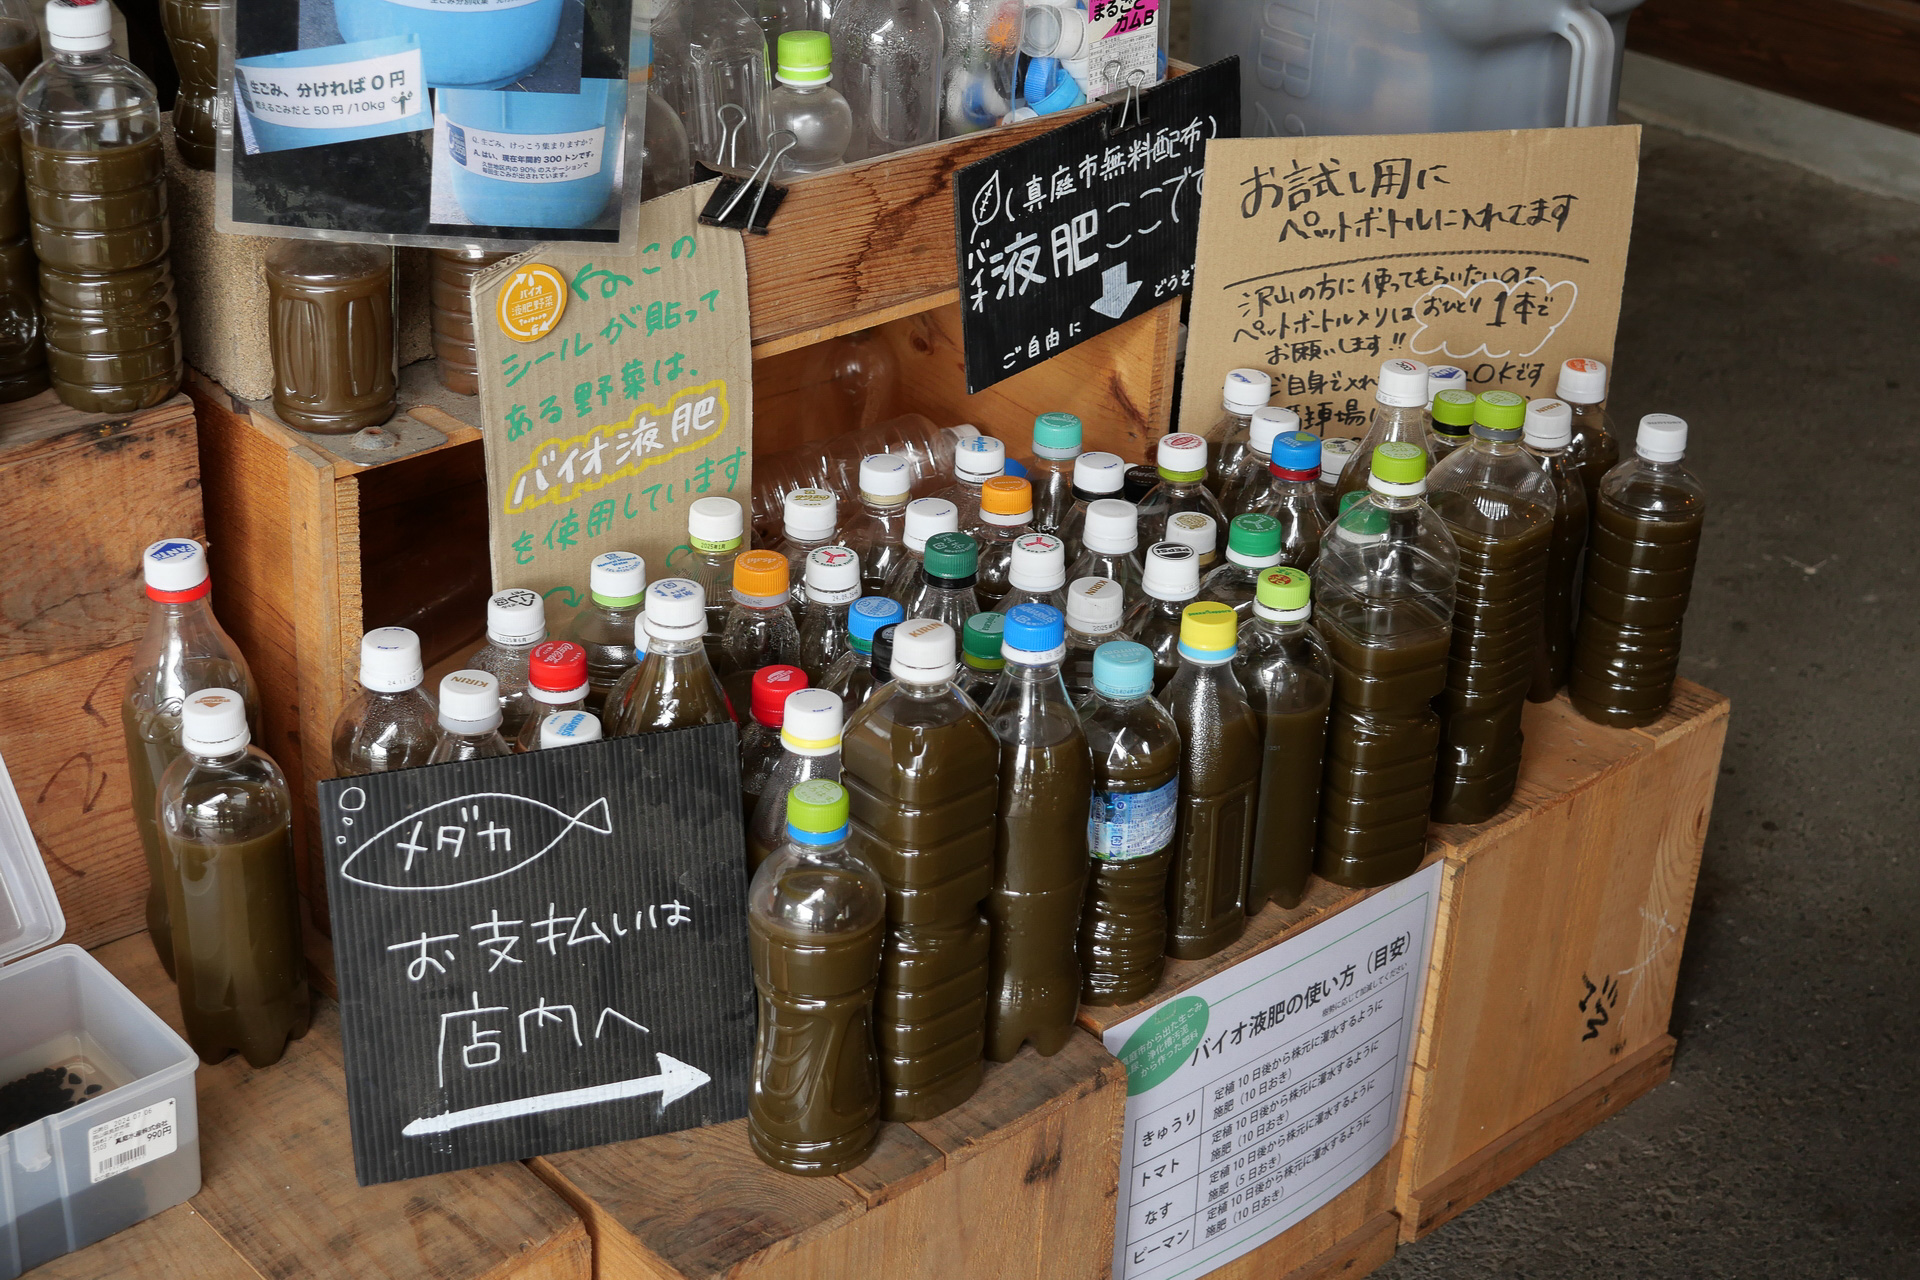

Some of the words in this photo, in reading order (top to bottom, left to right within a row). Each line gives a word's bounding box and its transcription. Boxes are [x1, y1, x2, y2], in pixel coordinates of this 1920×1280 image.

[1115, 9, 1155, 33] カムB
[1240, 157, 1450, 219] お試し用に
[1279, 194, 1578, 243] ペットボトルに入れてます
[642, 236, 696, 274] この
[520, 285, 543, 299] バイオ
[968, 239, 990, 313] バイオ
[512, 295, 553, 316] 液肥野菜
[502, 289, 720, 388] シールが貼って
[1003, 322, 1082, 369] ご自由に
[513, 396, 716, 504] バイオ液肥
[511, 446, 747, 565] を使用しています
[149, 543, 198, 561] FANTA
[1087, 580, 1108, 596] KIRIN
[909, 623, 943, 638] KIRIN
[451, 676, 488, 688] KIRIN
[561, 713, 587, 737] AQUARIUS
[397, 805, 511, 871] メダカ
[388, 900, 692, 981] お支払いは
[439, 991, 650, 1087] 店内へ
[147, 1125, 171, 1141] 990円
[1142, 1107, 1197, 1148] きゅうり
[1142, 1157, 1180, 1188] トマト
[1144, 1201, 1172, 1226] なす
[1133, 1228, 1190, 1265] ピーマン
